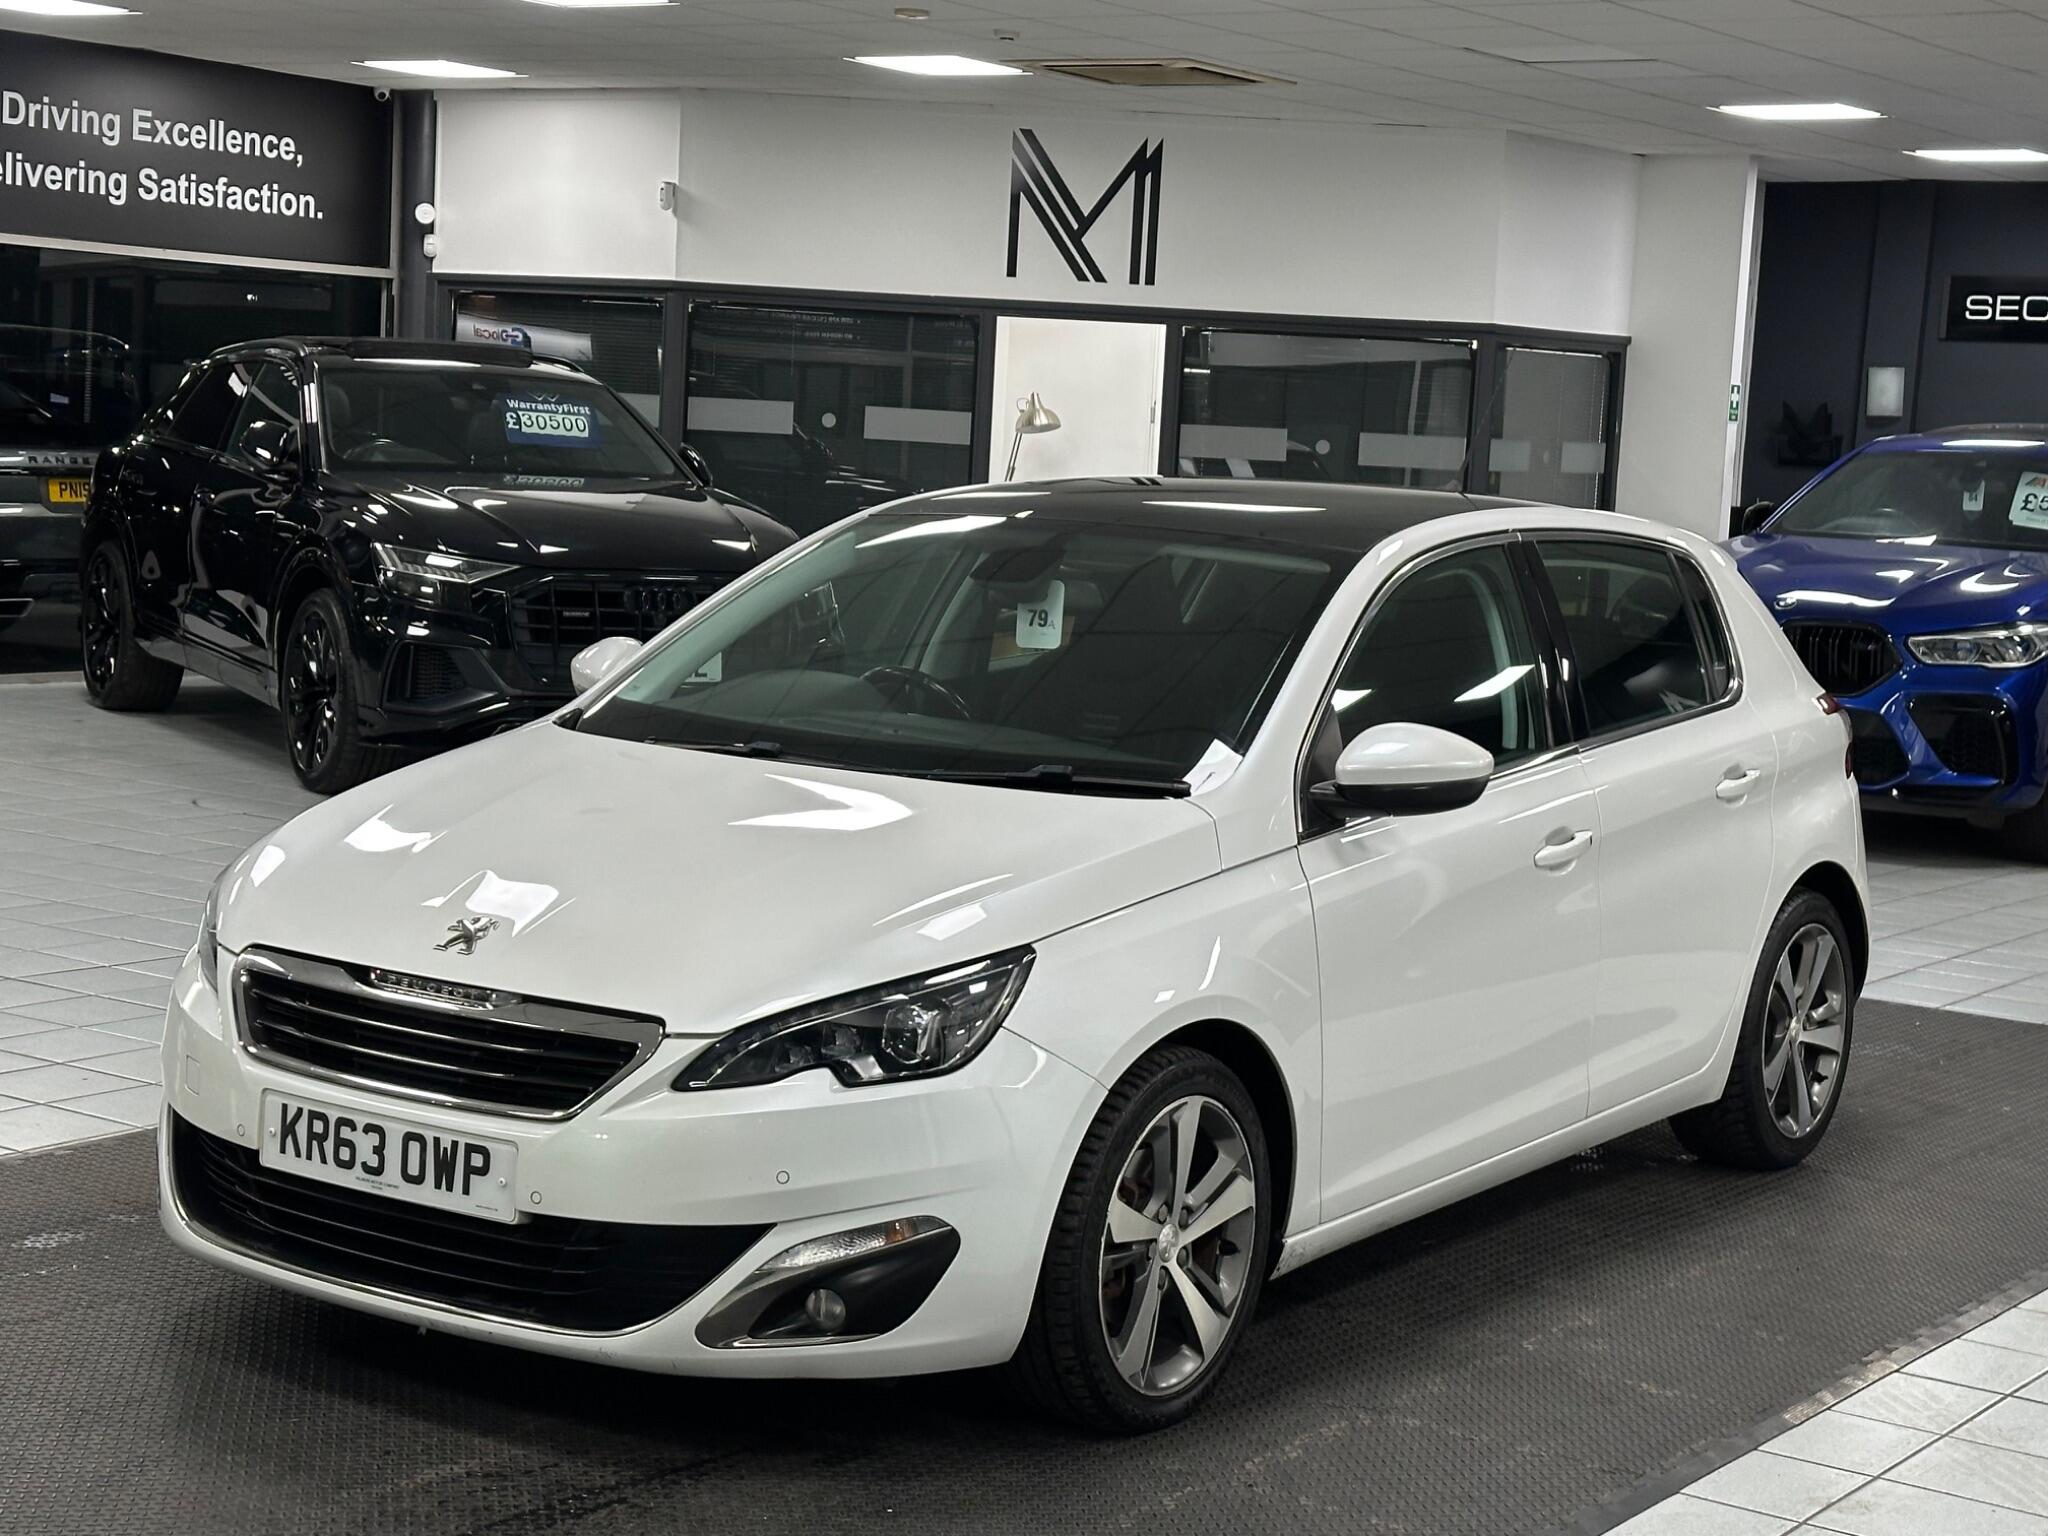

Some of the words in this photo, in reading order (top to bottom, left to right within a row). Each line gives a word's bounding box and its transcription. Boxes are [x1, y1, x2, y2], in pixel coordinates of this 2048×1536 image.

[2, 90, 121, 146] Driving
[132, 108, 303, 167] Excellence,
[0, 152, 127, 206] livering
[138, 167, 324, 220] Satisfaction.
[506, 399, 591, 415] WarrantyFirst
[506, 411, 587, 433] £30500
[27, 455, 91, 465] RANGE
[278, 1102, 387, 1177] KR63
[400, 1130, 491, 1196] OWP
